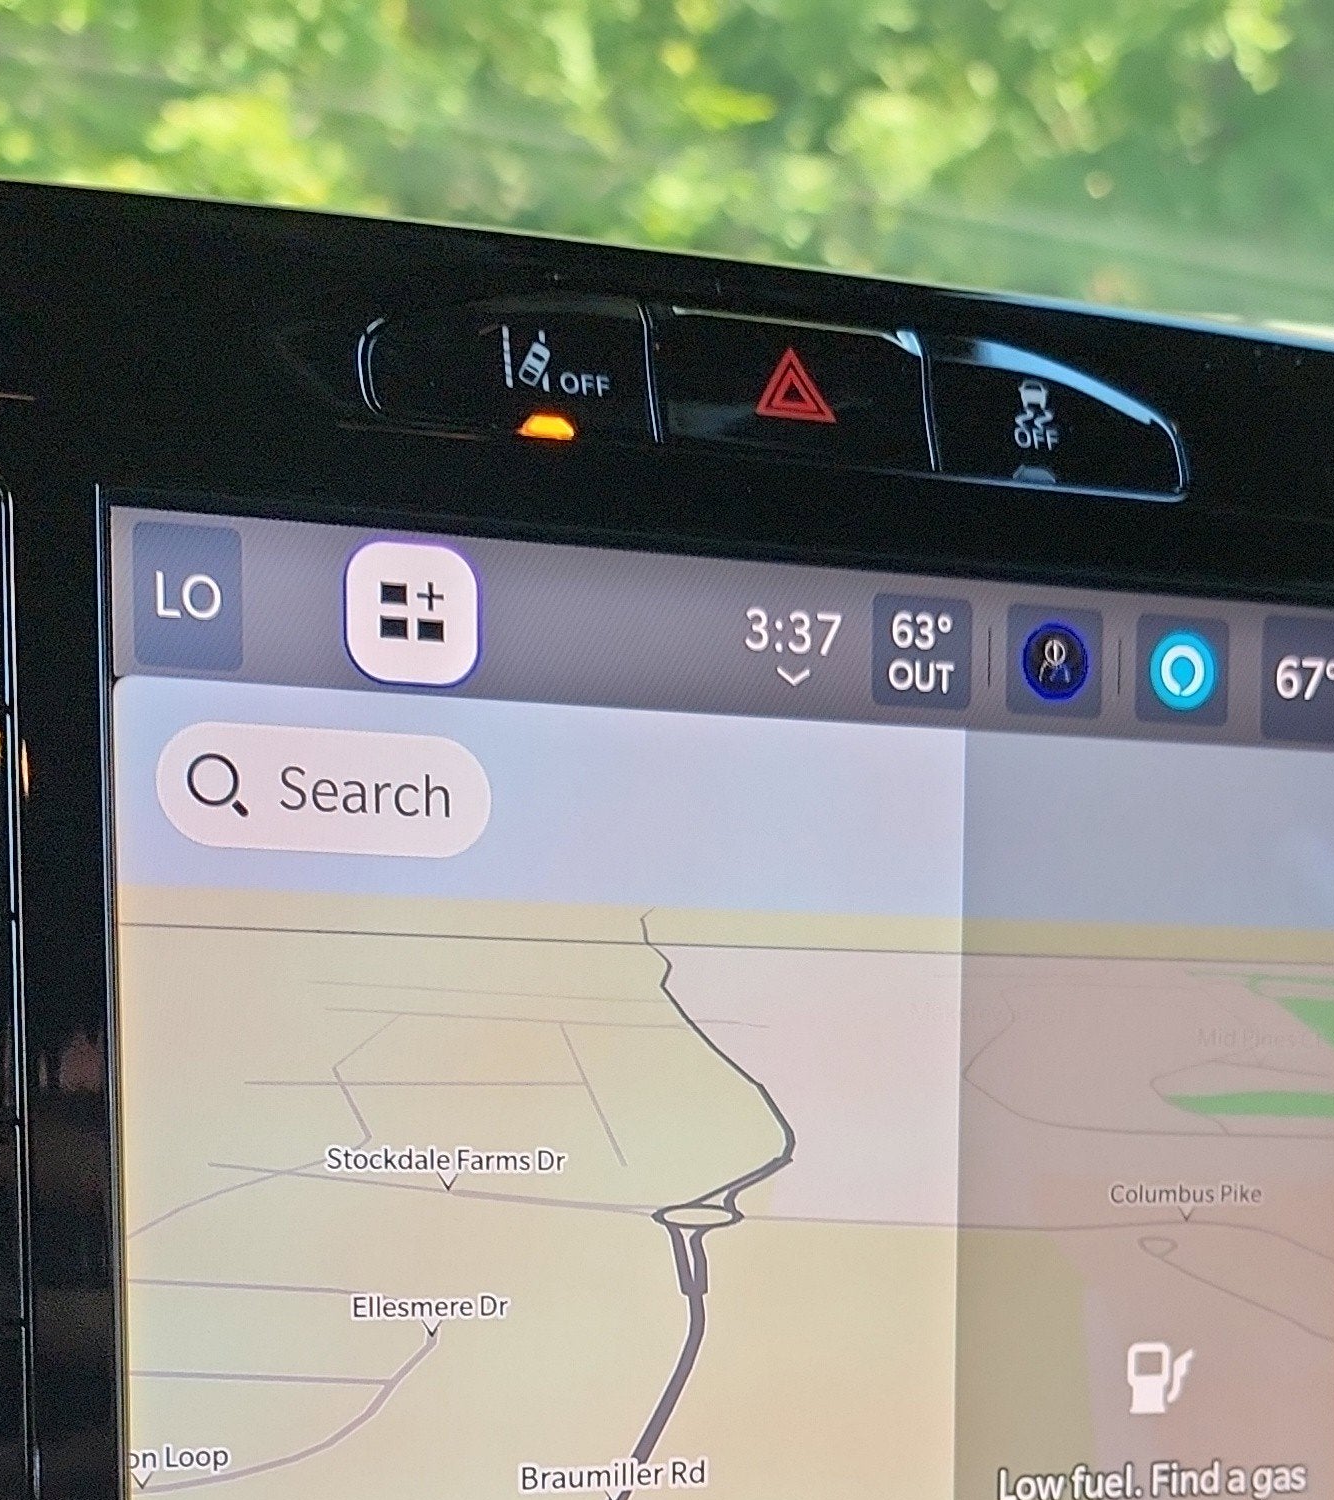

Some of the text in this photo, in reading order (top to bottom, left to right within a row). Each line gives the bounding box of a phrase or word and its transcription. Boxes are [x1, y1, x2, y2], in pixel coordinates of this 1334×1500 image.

[560, 372, 610, 397] OFF
[1014, 424, 1059, 452] OFF
[155, 570, 223, 621] LO
[744, 607, 843, 658] 3:37
[891, 611, 953, 650] 63°
[888, 658, 955, 694] OUT
[279, 766, 451, 818] Search
[326, 1148, 566, 1172] Stockdale Farms Dr
[1110, 1184, 1262, 1204] Columbus Pike
[353, 1297, 508, 1318] Ellesmere Dr
[165, 1446, 229, 1471] Loop
[522, 1462, 706, 1490] Braumiller Rd
[1071, 1463, 1143, 1500] fuel.
[1152, 1459, 1220, 1497] Find
[1228, 1468, 1246, 1493] a
[1253, 1466, 1307, 1500] gas
